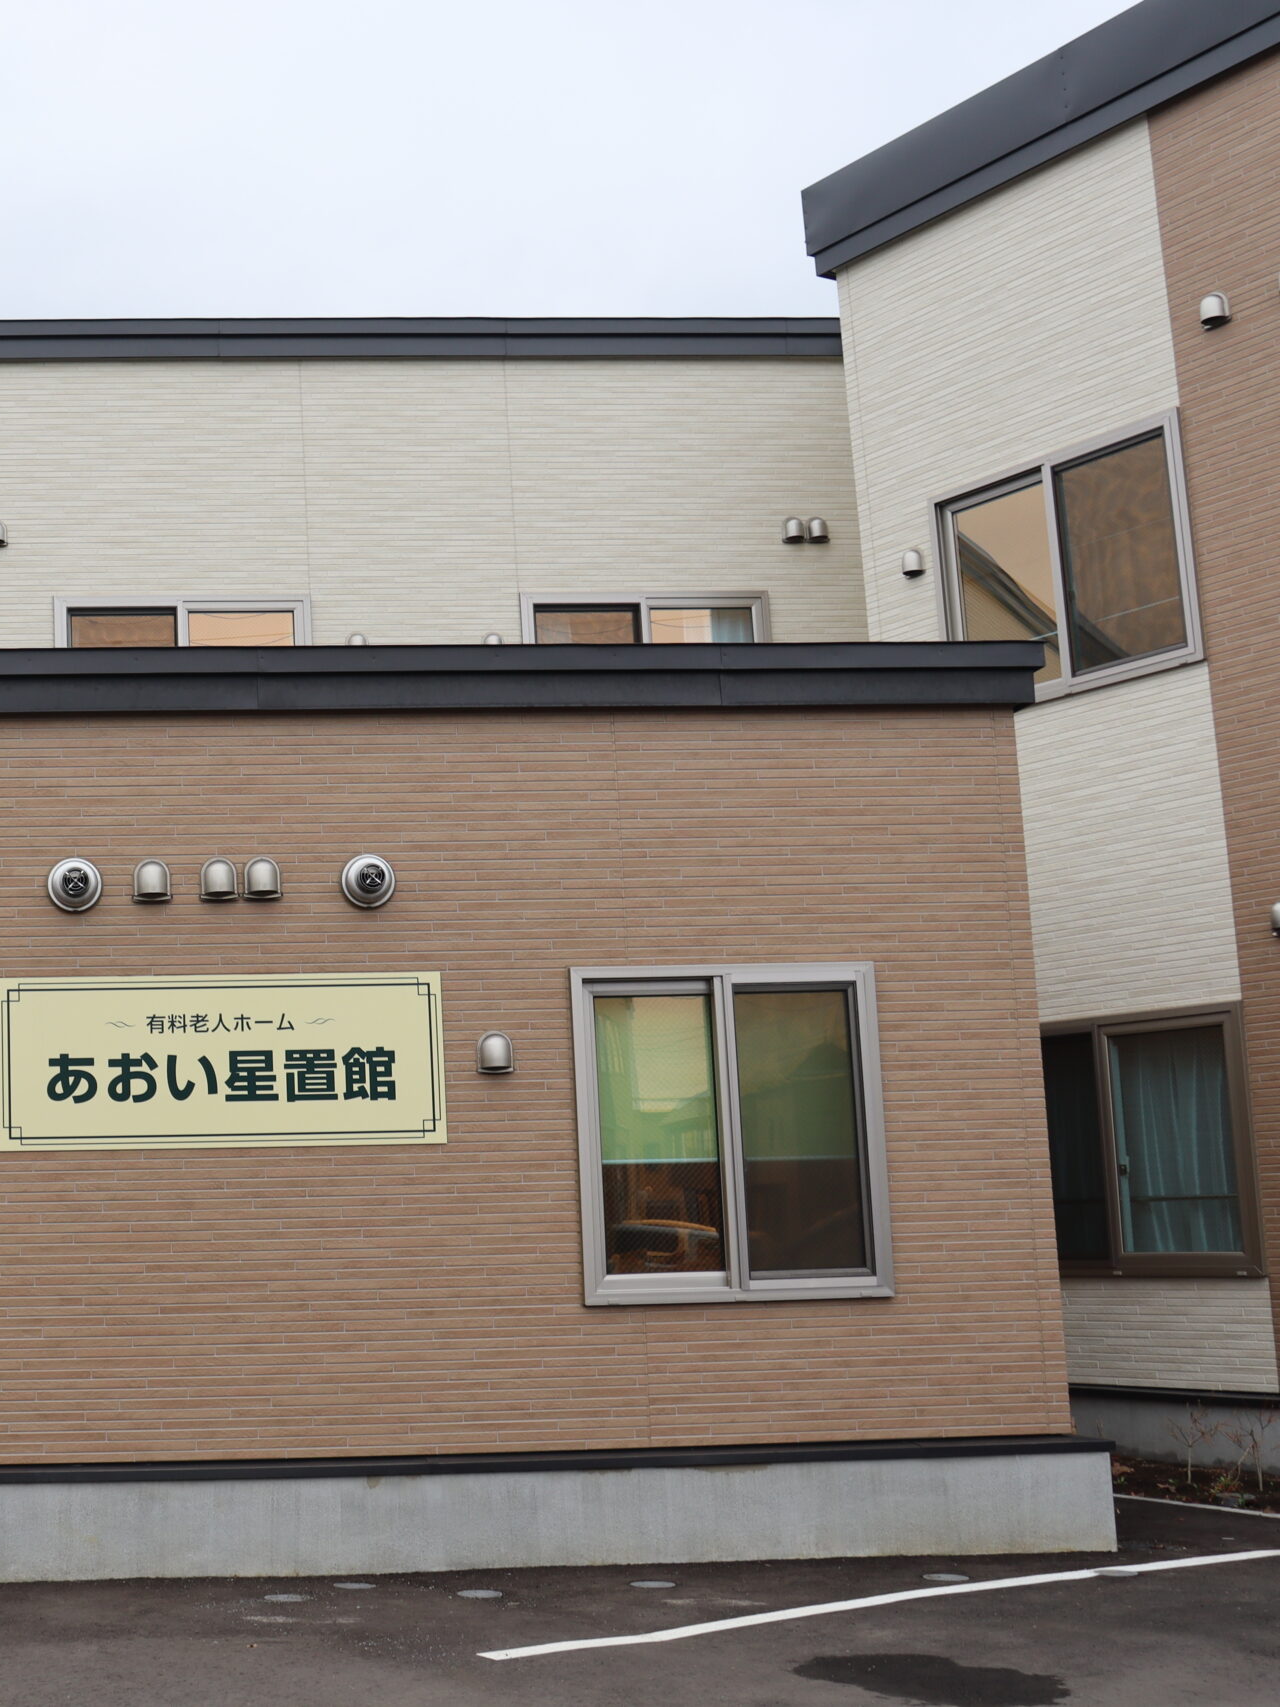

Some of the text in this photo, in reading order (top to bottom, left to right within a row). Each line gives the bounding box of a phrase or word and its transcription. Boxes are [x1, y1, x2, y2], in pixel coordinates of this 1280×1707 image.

[146, 1013, 294, 1034] 有料老人ホーム
[47, 1047, 396, 1103] あおい星置館
